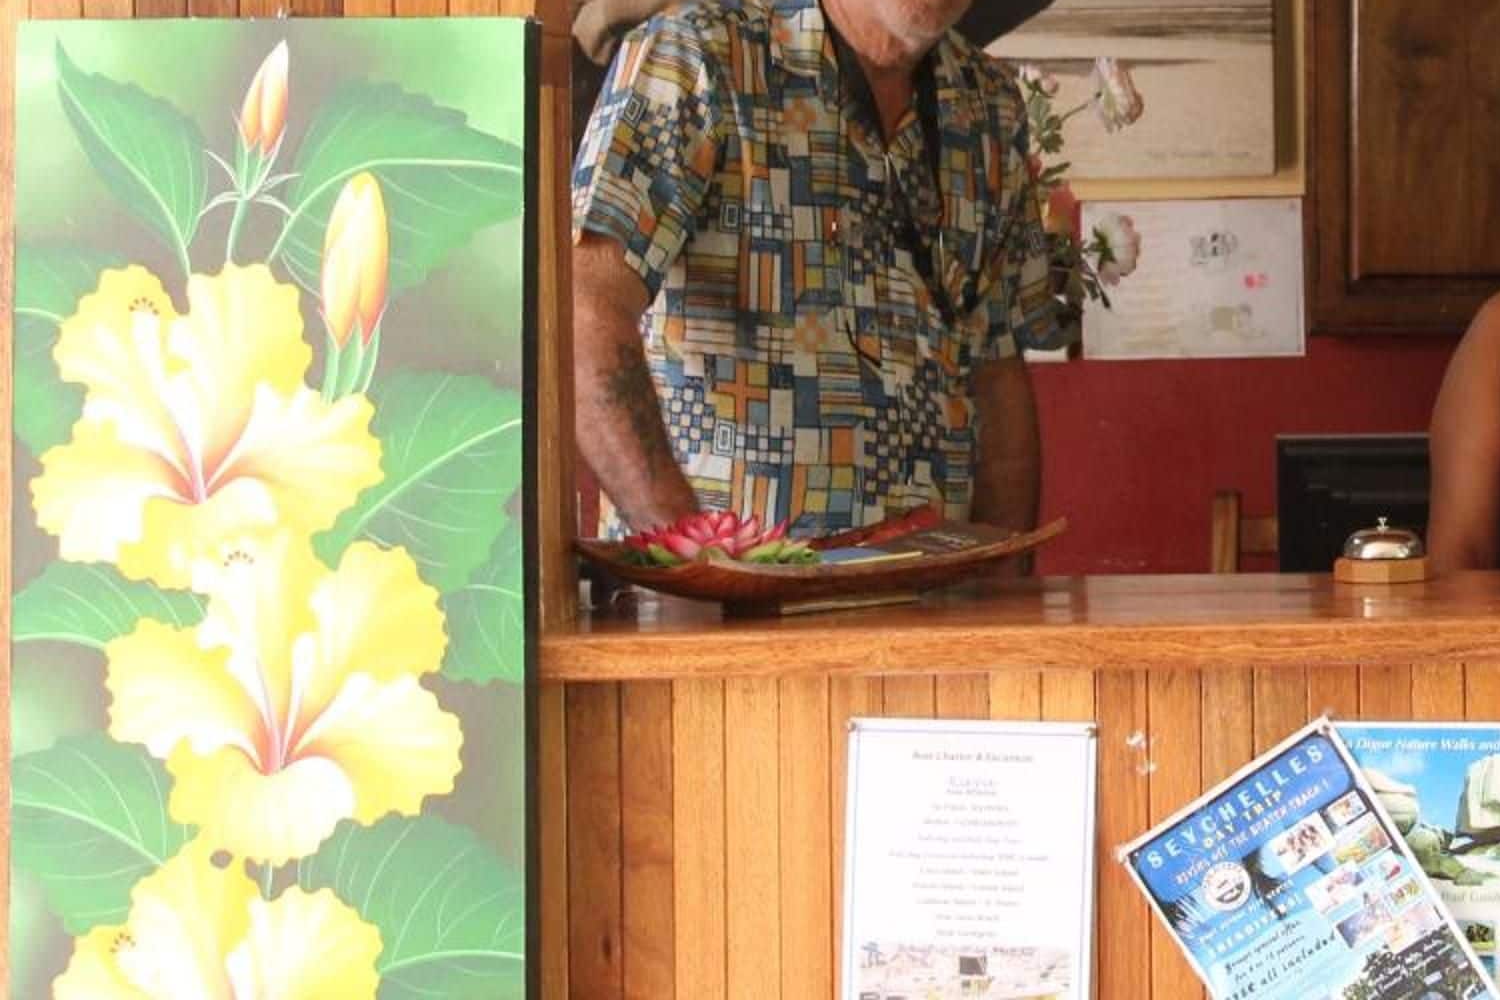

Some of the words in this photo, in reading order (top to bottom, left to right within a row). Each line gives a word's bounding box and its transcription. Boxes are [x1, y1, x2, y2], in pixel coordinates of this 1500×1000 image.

[1396, 738, 1435, 750] Nature
[1439, 737, 1475, 750] Walks
[1479, 738, 1500, 751] and
[1146, 744, 1324, 869] SEYCHELLES
[1201, 821, 1236, 849] DAY
[1242, 789, 1283, 821] TRIP
